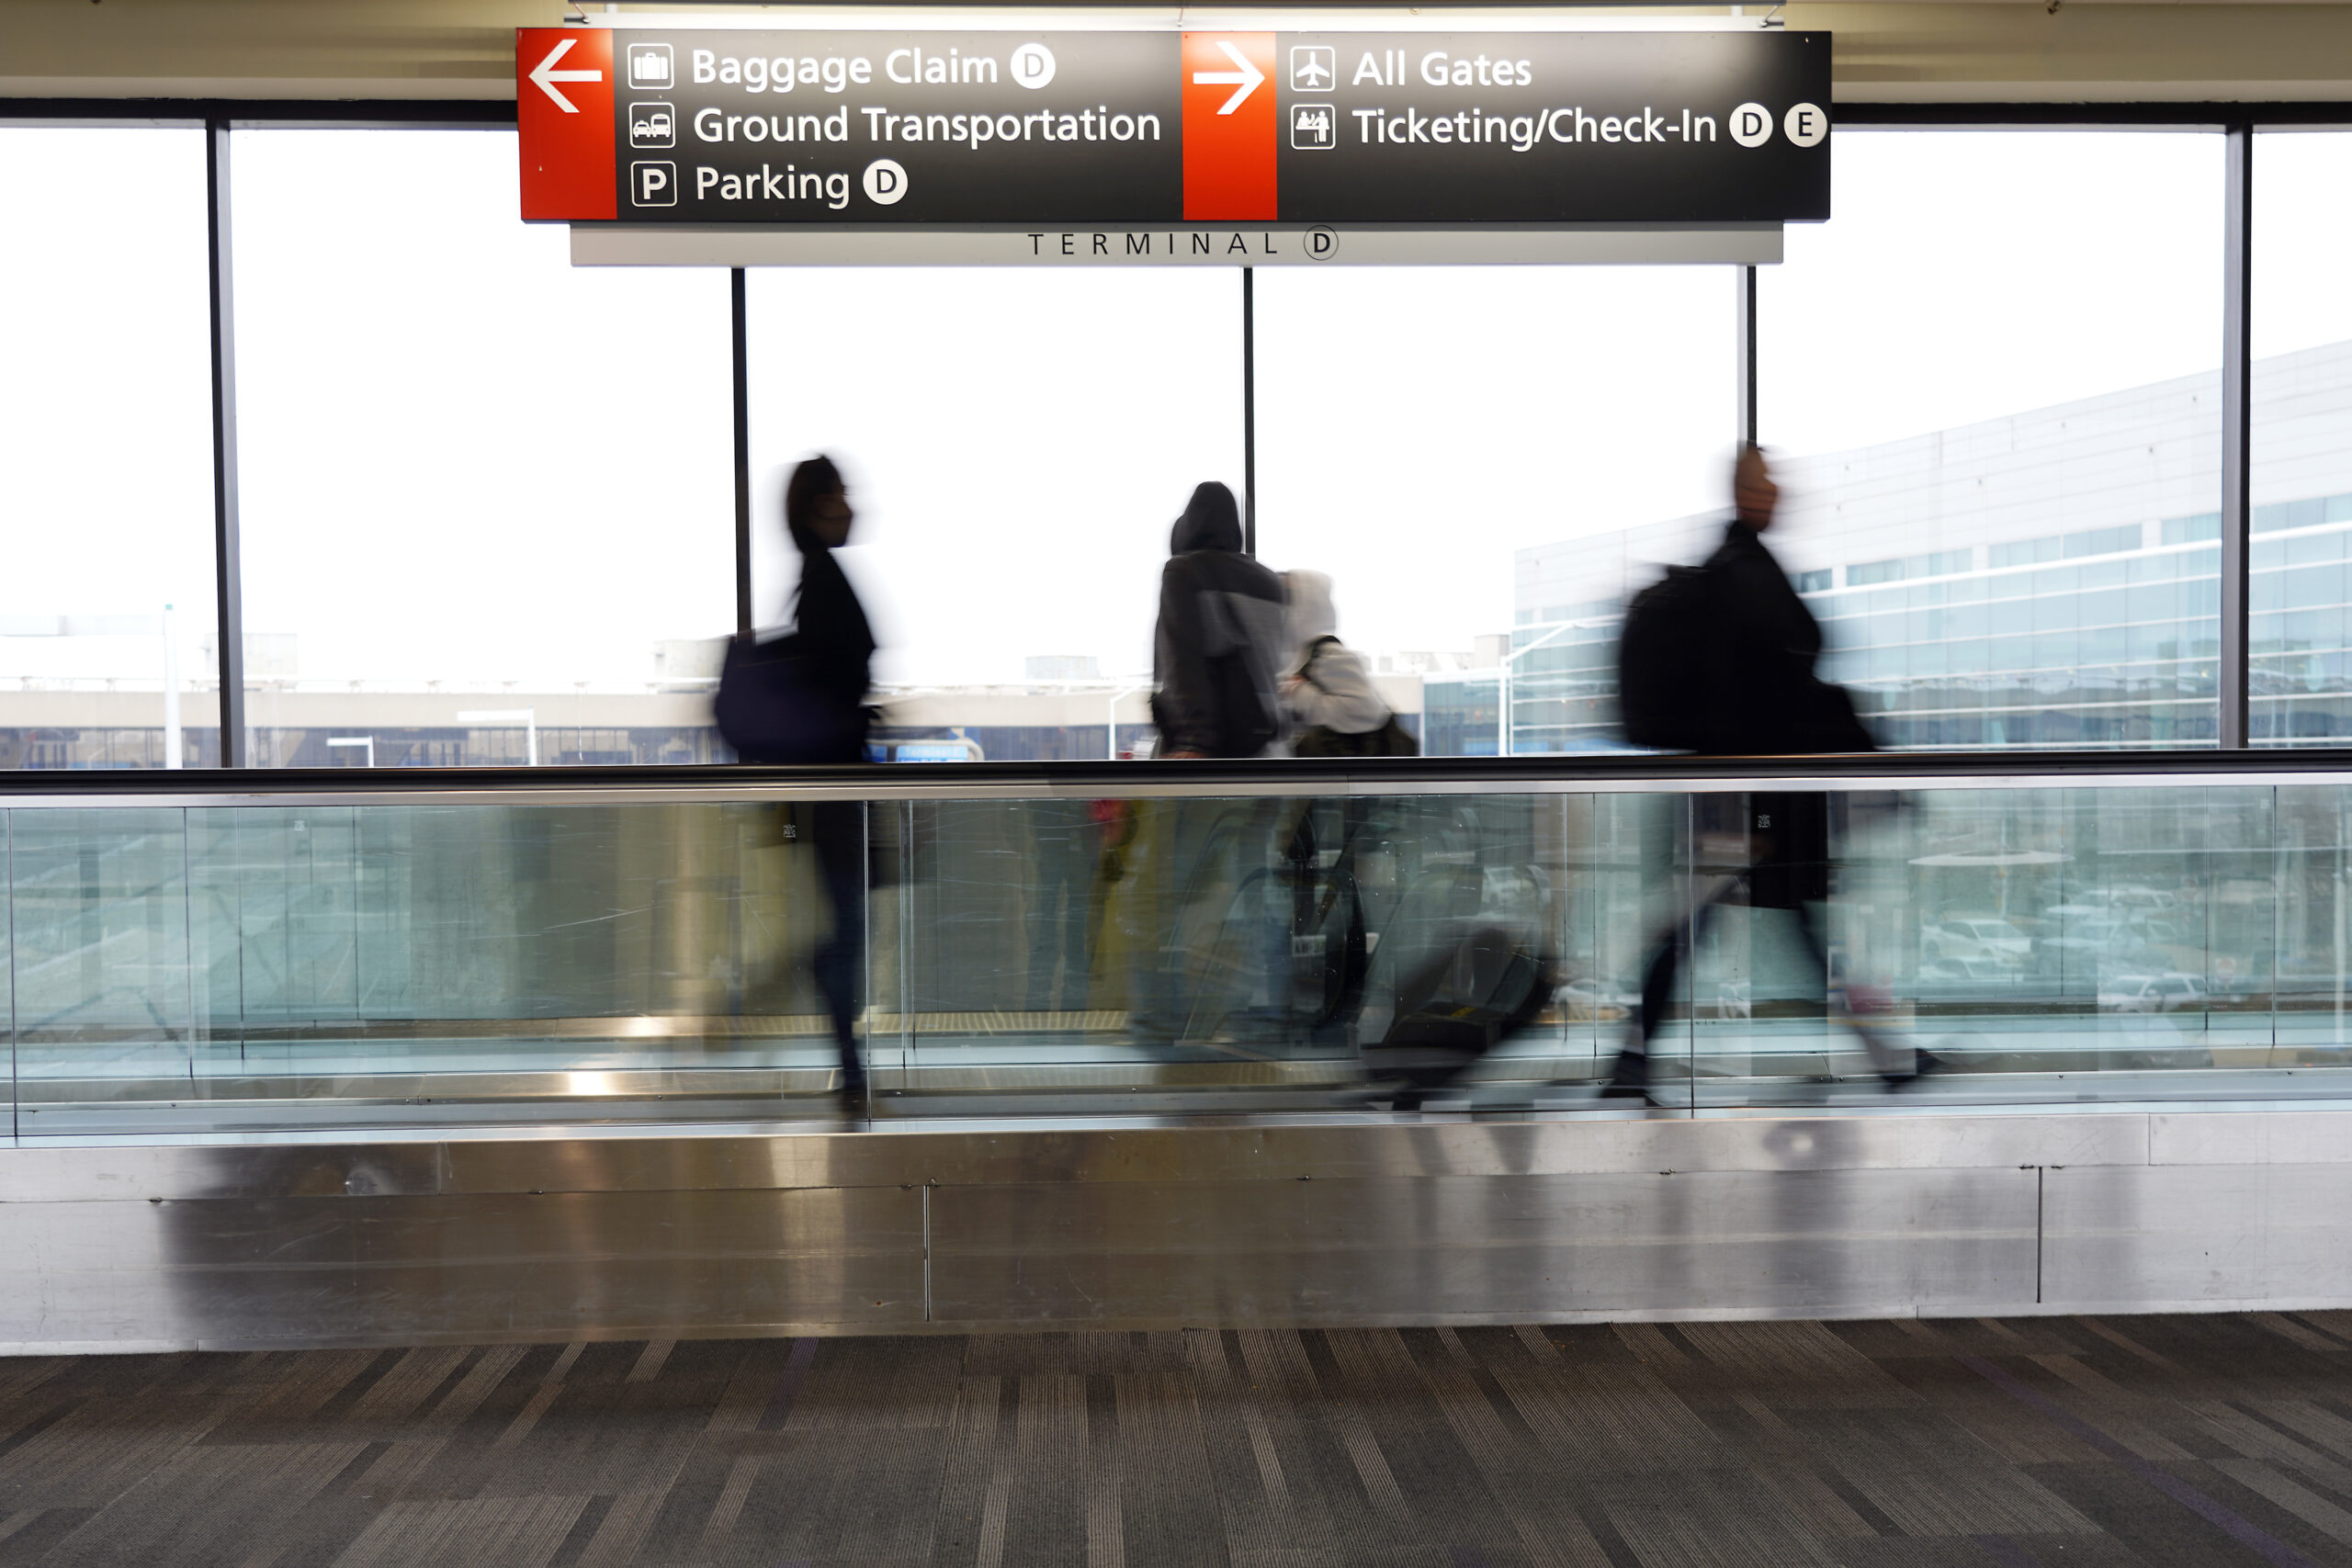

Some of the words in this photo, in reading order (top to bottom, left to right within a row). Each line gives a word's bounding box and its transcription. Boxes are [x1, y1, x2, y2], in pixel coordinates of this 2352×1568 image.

[692, 50, 872, 94] Baggage
[886, 48, 998, 84] Claim
[1025, 54, 1044, 78] D
[1352, 51, 1406, 85] All
[1420, 52, 1532, 86] Gates
[694, 106, 848, 142] Ground
[862, 107, 1160, 150] Transportation
[1352, 107, 1716, 152] Ticketing/Check-In
[1742, 113, 1762, 137] D
[1798, 112, 1813, 137] E
[643, 170, 667, 199] P
[696, 164, 849, 209] Parking
[876, 169, 897, 194] D
[1028, 233, 1278, 255] TERMINAL
[1314, 233, 1330, 254] D
